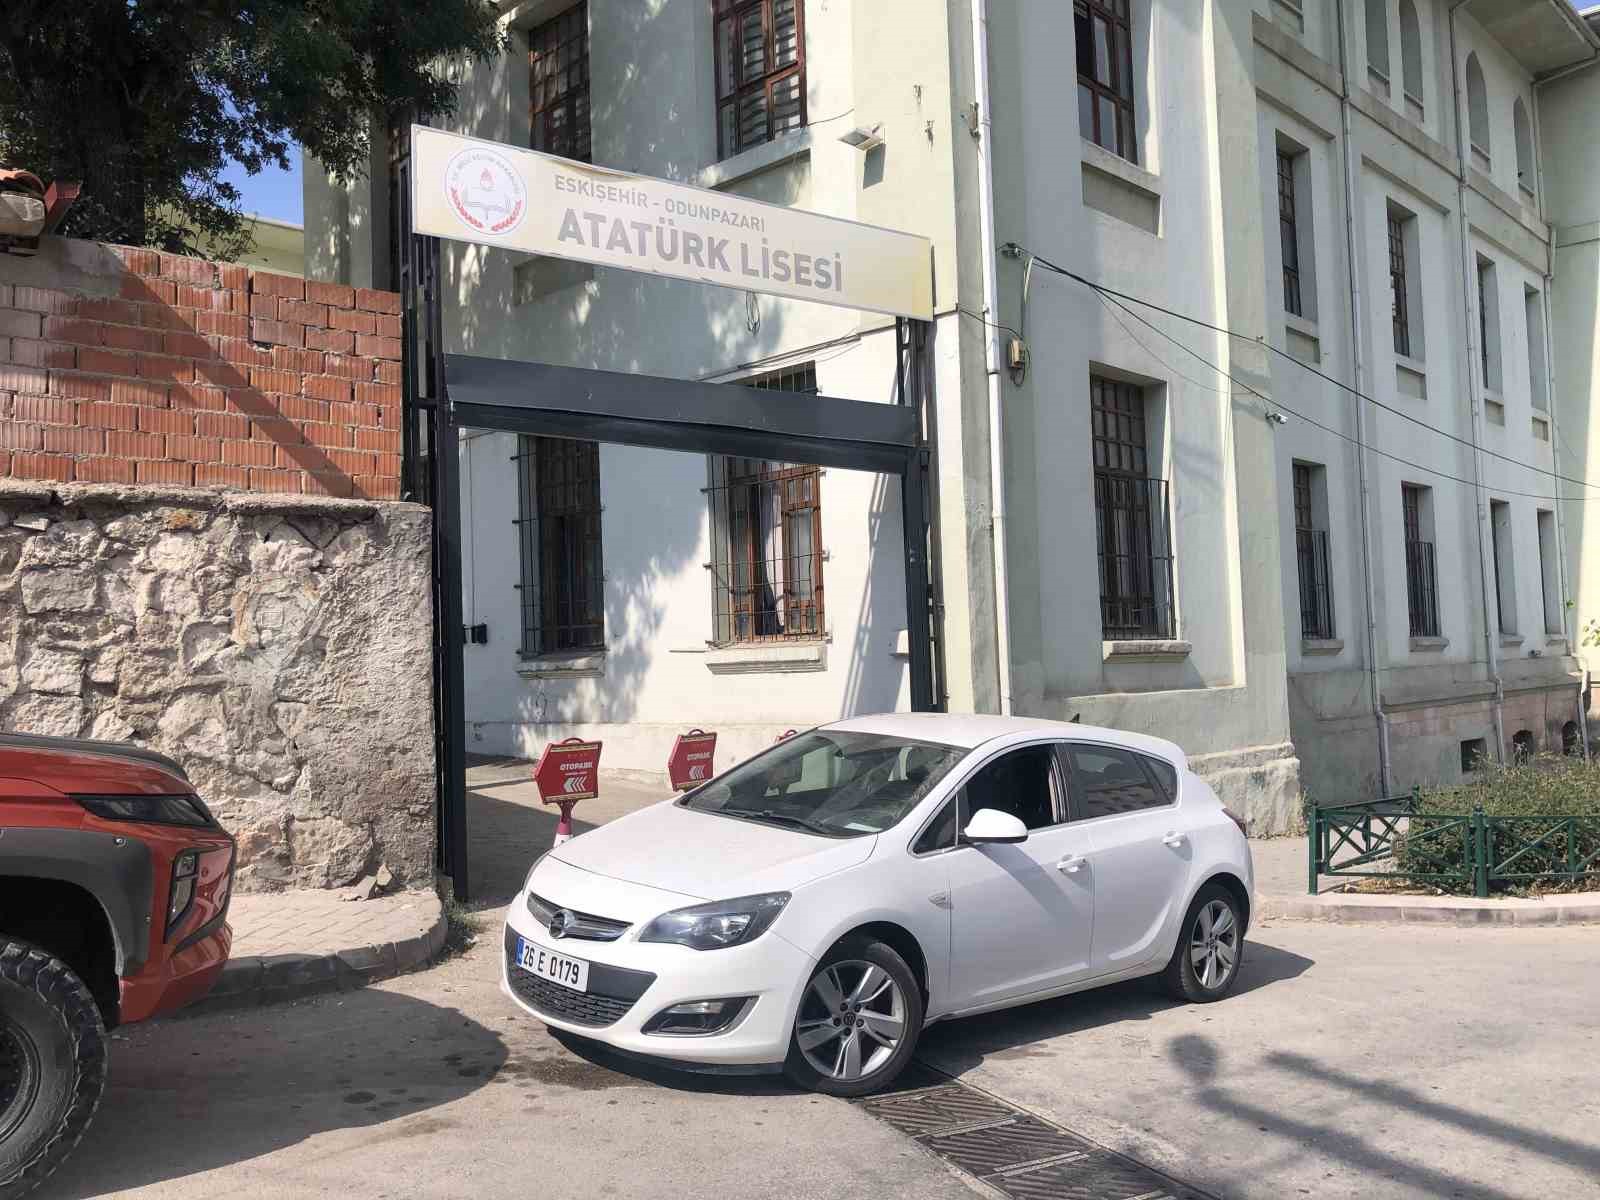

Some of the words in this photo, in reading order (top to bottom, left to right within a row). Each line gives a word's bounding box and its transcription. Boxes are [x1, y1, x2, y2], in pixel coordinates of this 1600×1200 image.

[664, 198, 765, 232] ODUNPAZARI
[558, 207, 731, 272] ATATÜRK
[741, 238, 842, 291] LİSESİ
[524, 945, 535, 967] 26
[538, 951, 546, 972] E
[550, 956, 579, 984] 0179
